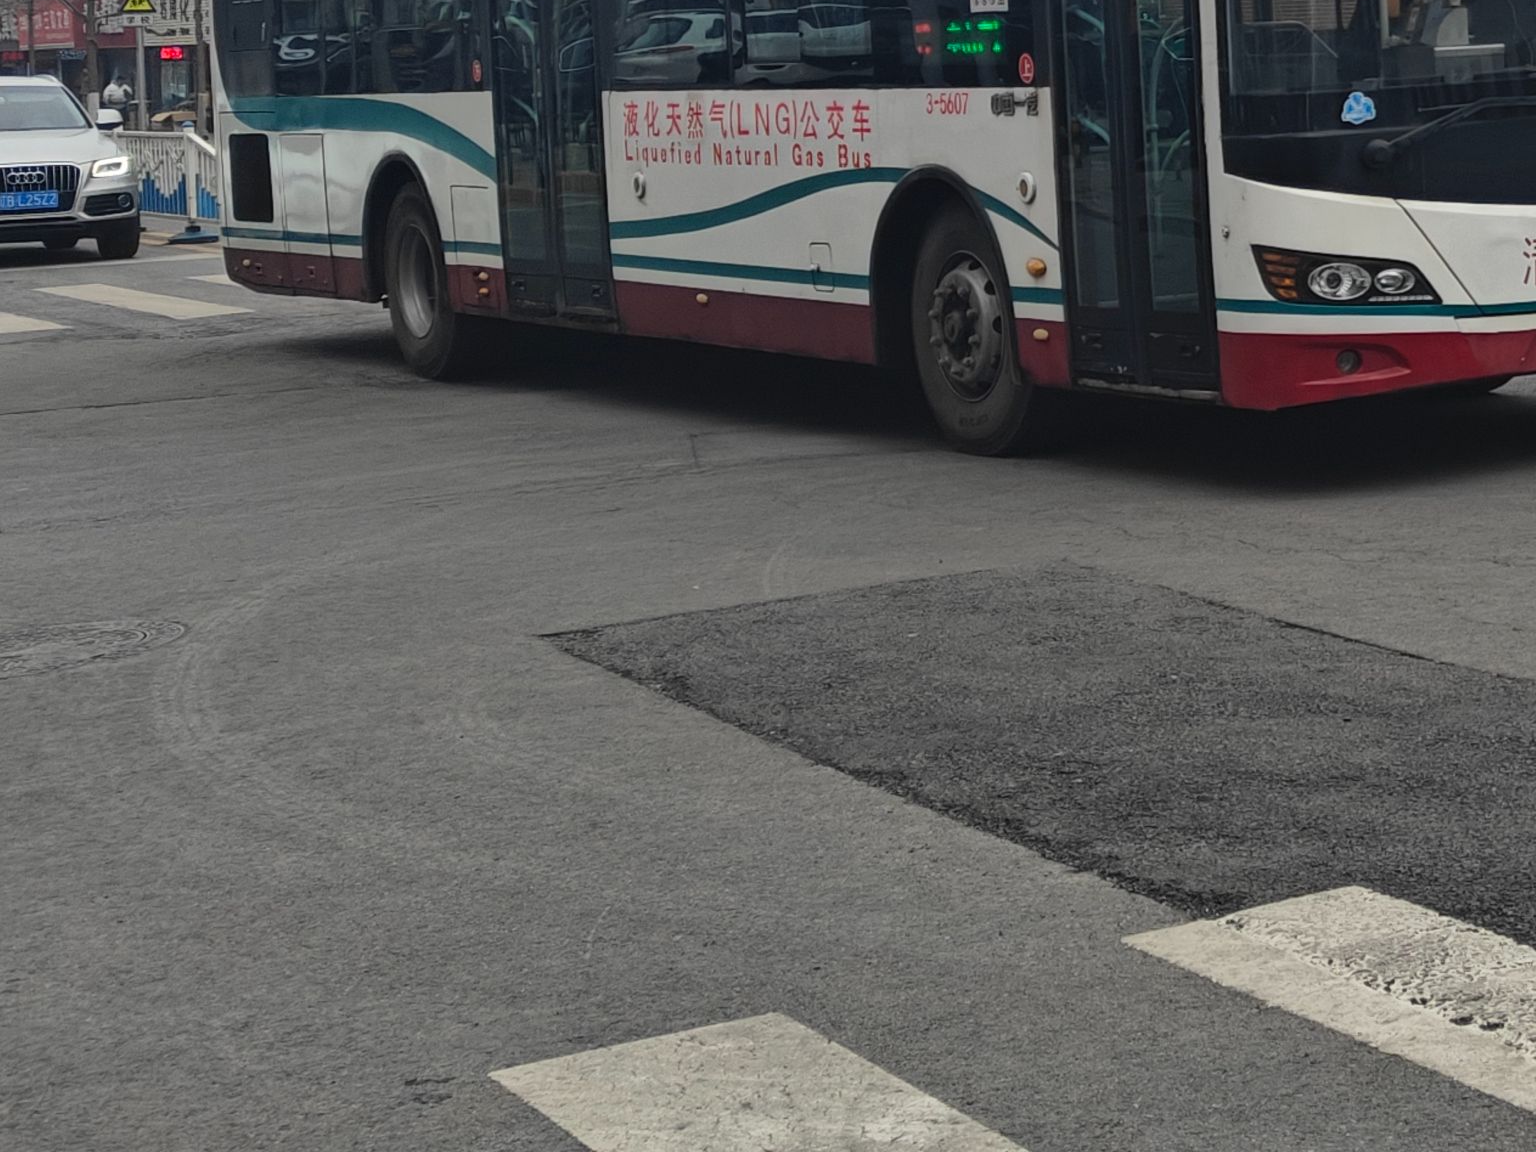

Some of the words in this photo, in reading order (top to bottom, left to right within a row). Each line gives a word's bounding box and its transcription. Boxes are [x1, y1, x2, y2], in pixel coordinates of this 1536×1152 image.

[127, 16, 150, 24] 学校
[926, 93, 969, 115] 3-5607
[623, 100, 871, 141] 液化天然气(LNG)公交车
[624, 141, 701, 167] Liquefied
[713, 143, 778, 166] Natural
[792, 143, 824, 167] Gas
[838, 144, 872, 169] Bus
